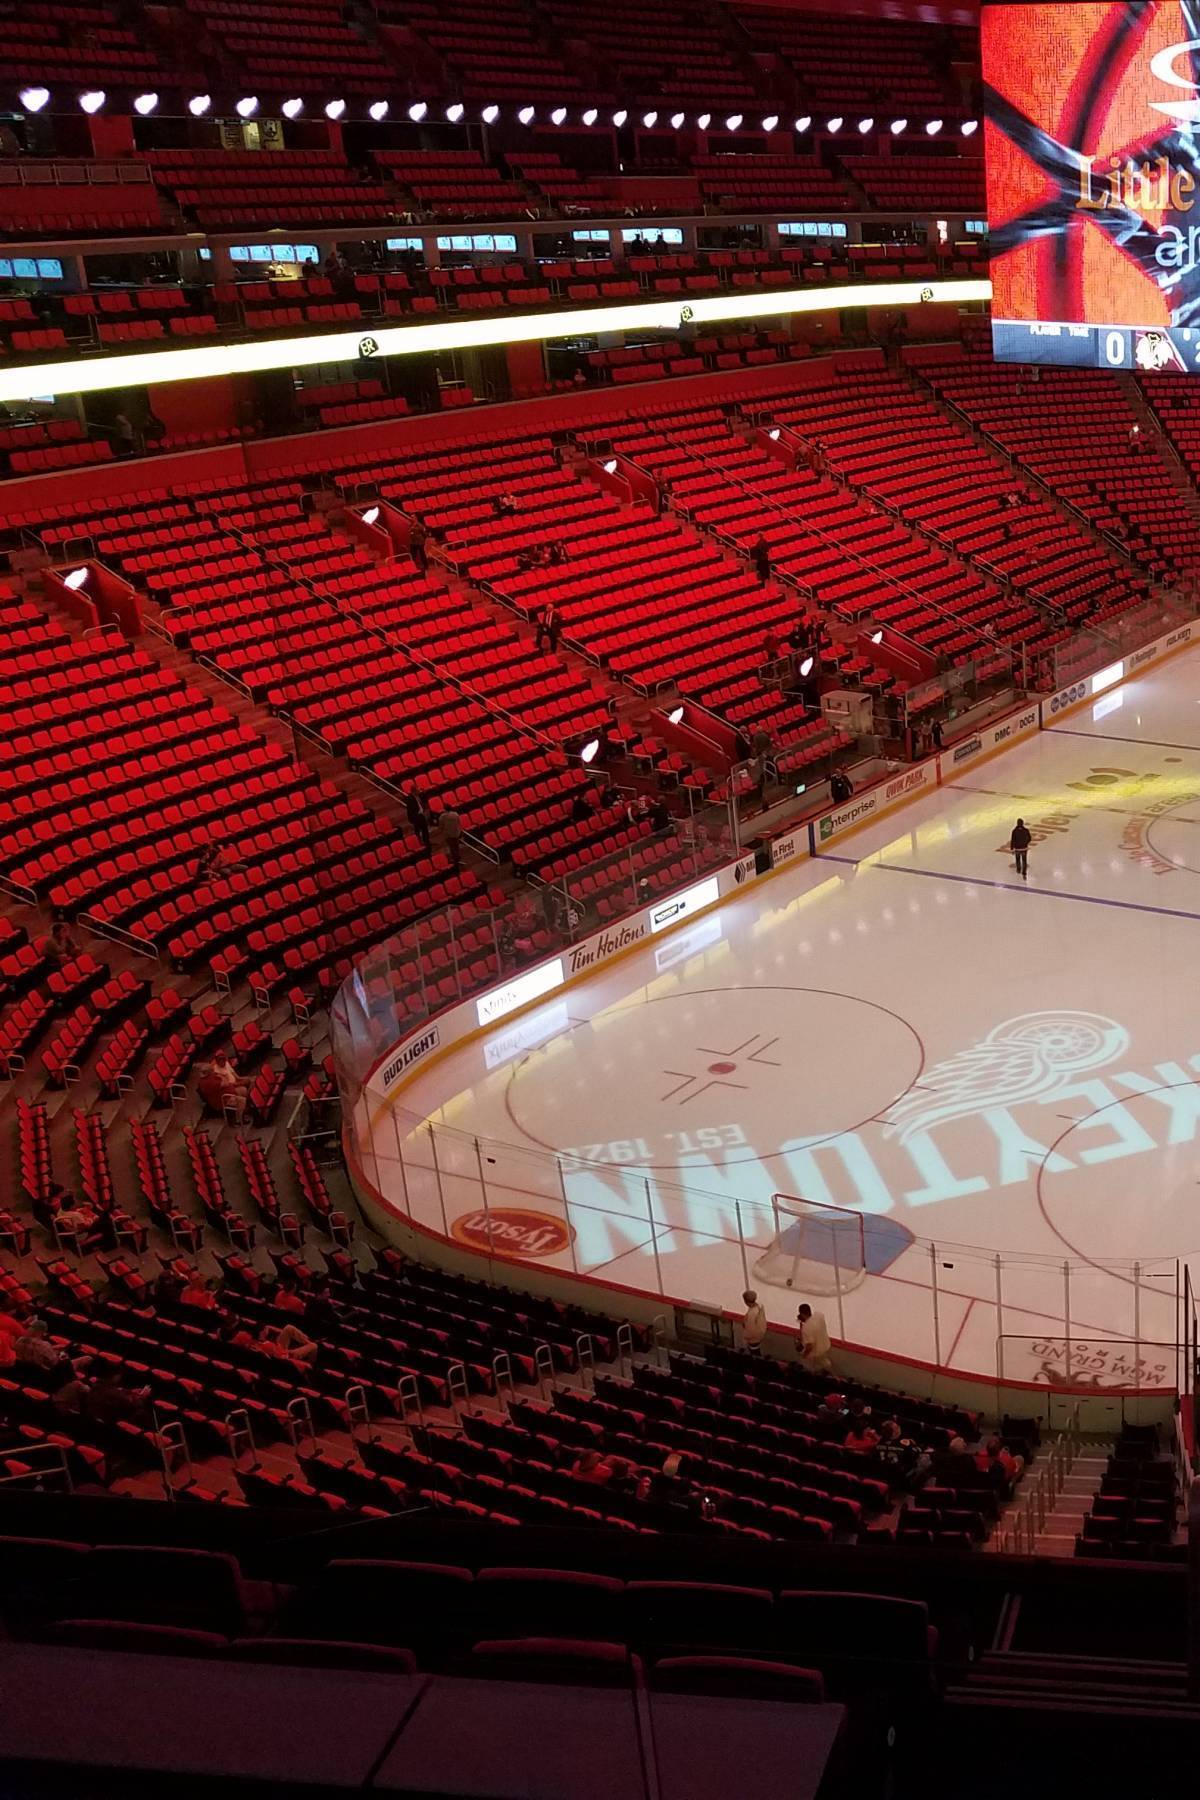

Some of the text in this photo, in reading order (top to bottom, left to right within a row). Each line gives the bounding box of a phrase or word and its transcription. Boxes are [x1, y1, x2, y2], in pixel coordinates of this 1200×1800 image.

[1076, 155, 1196, 211] Little
[1106, 332, 1125, 365] 0
[824, 799, 875, 836] enterprise
[779, 840, 794, 855] First
[569, 926, 646, 973] Tim Hortons
[383, 1033, 437, 1086] BUD LIGHT
[664, 1123, 748, 1154] EST.
[463, 1216, 557, 1250] Tyson
